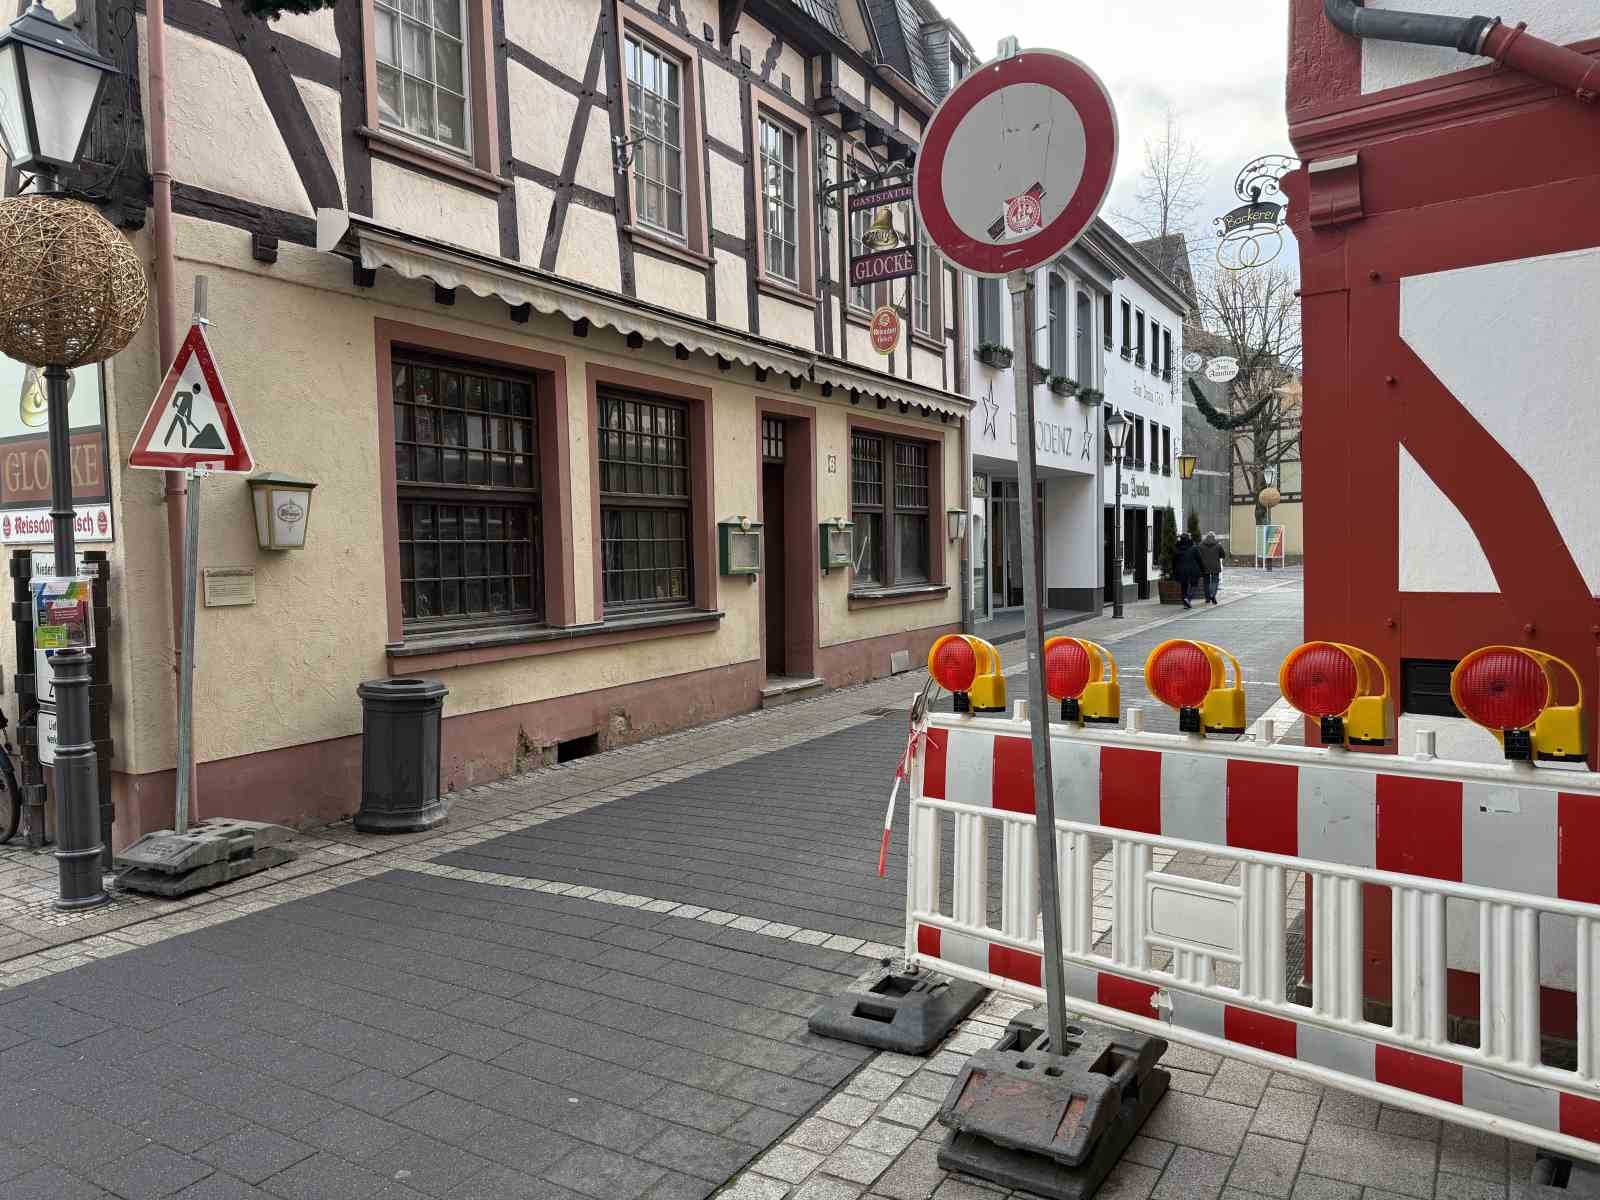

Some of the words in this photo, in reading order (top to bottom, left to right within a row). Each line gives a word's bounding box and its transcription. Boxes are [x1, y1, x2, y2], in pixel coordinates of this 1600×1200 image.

[855, 254, 913, 279] GLOCKE
[5, 443, 98, 493] GLOKE
[15, 514, 54, 534] Reissdor
